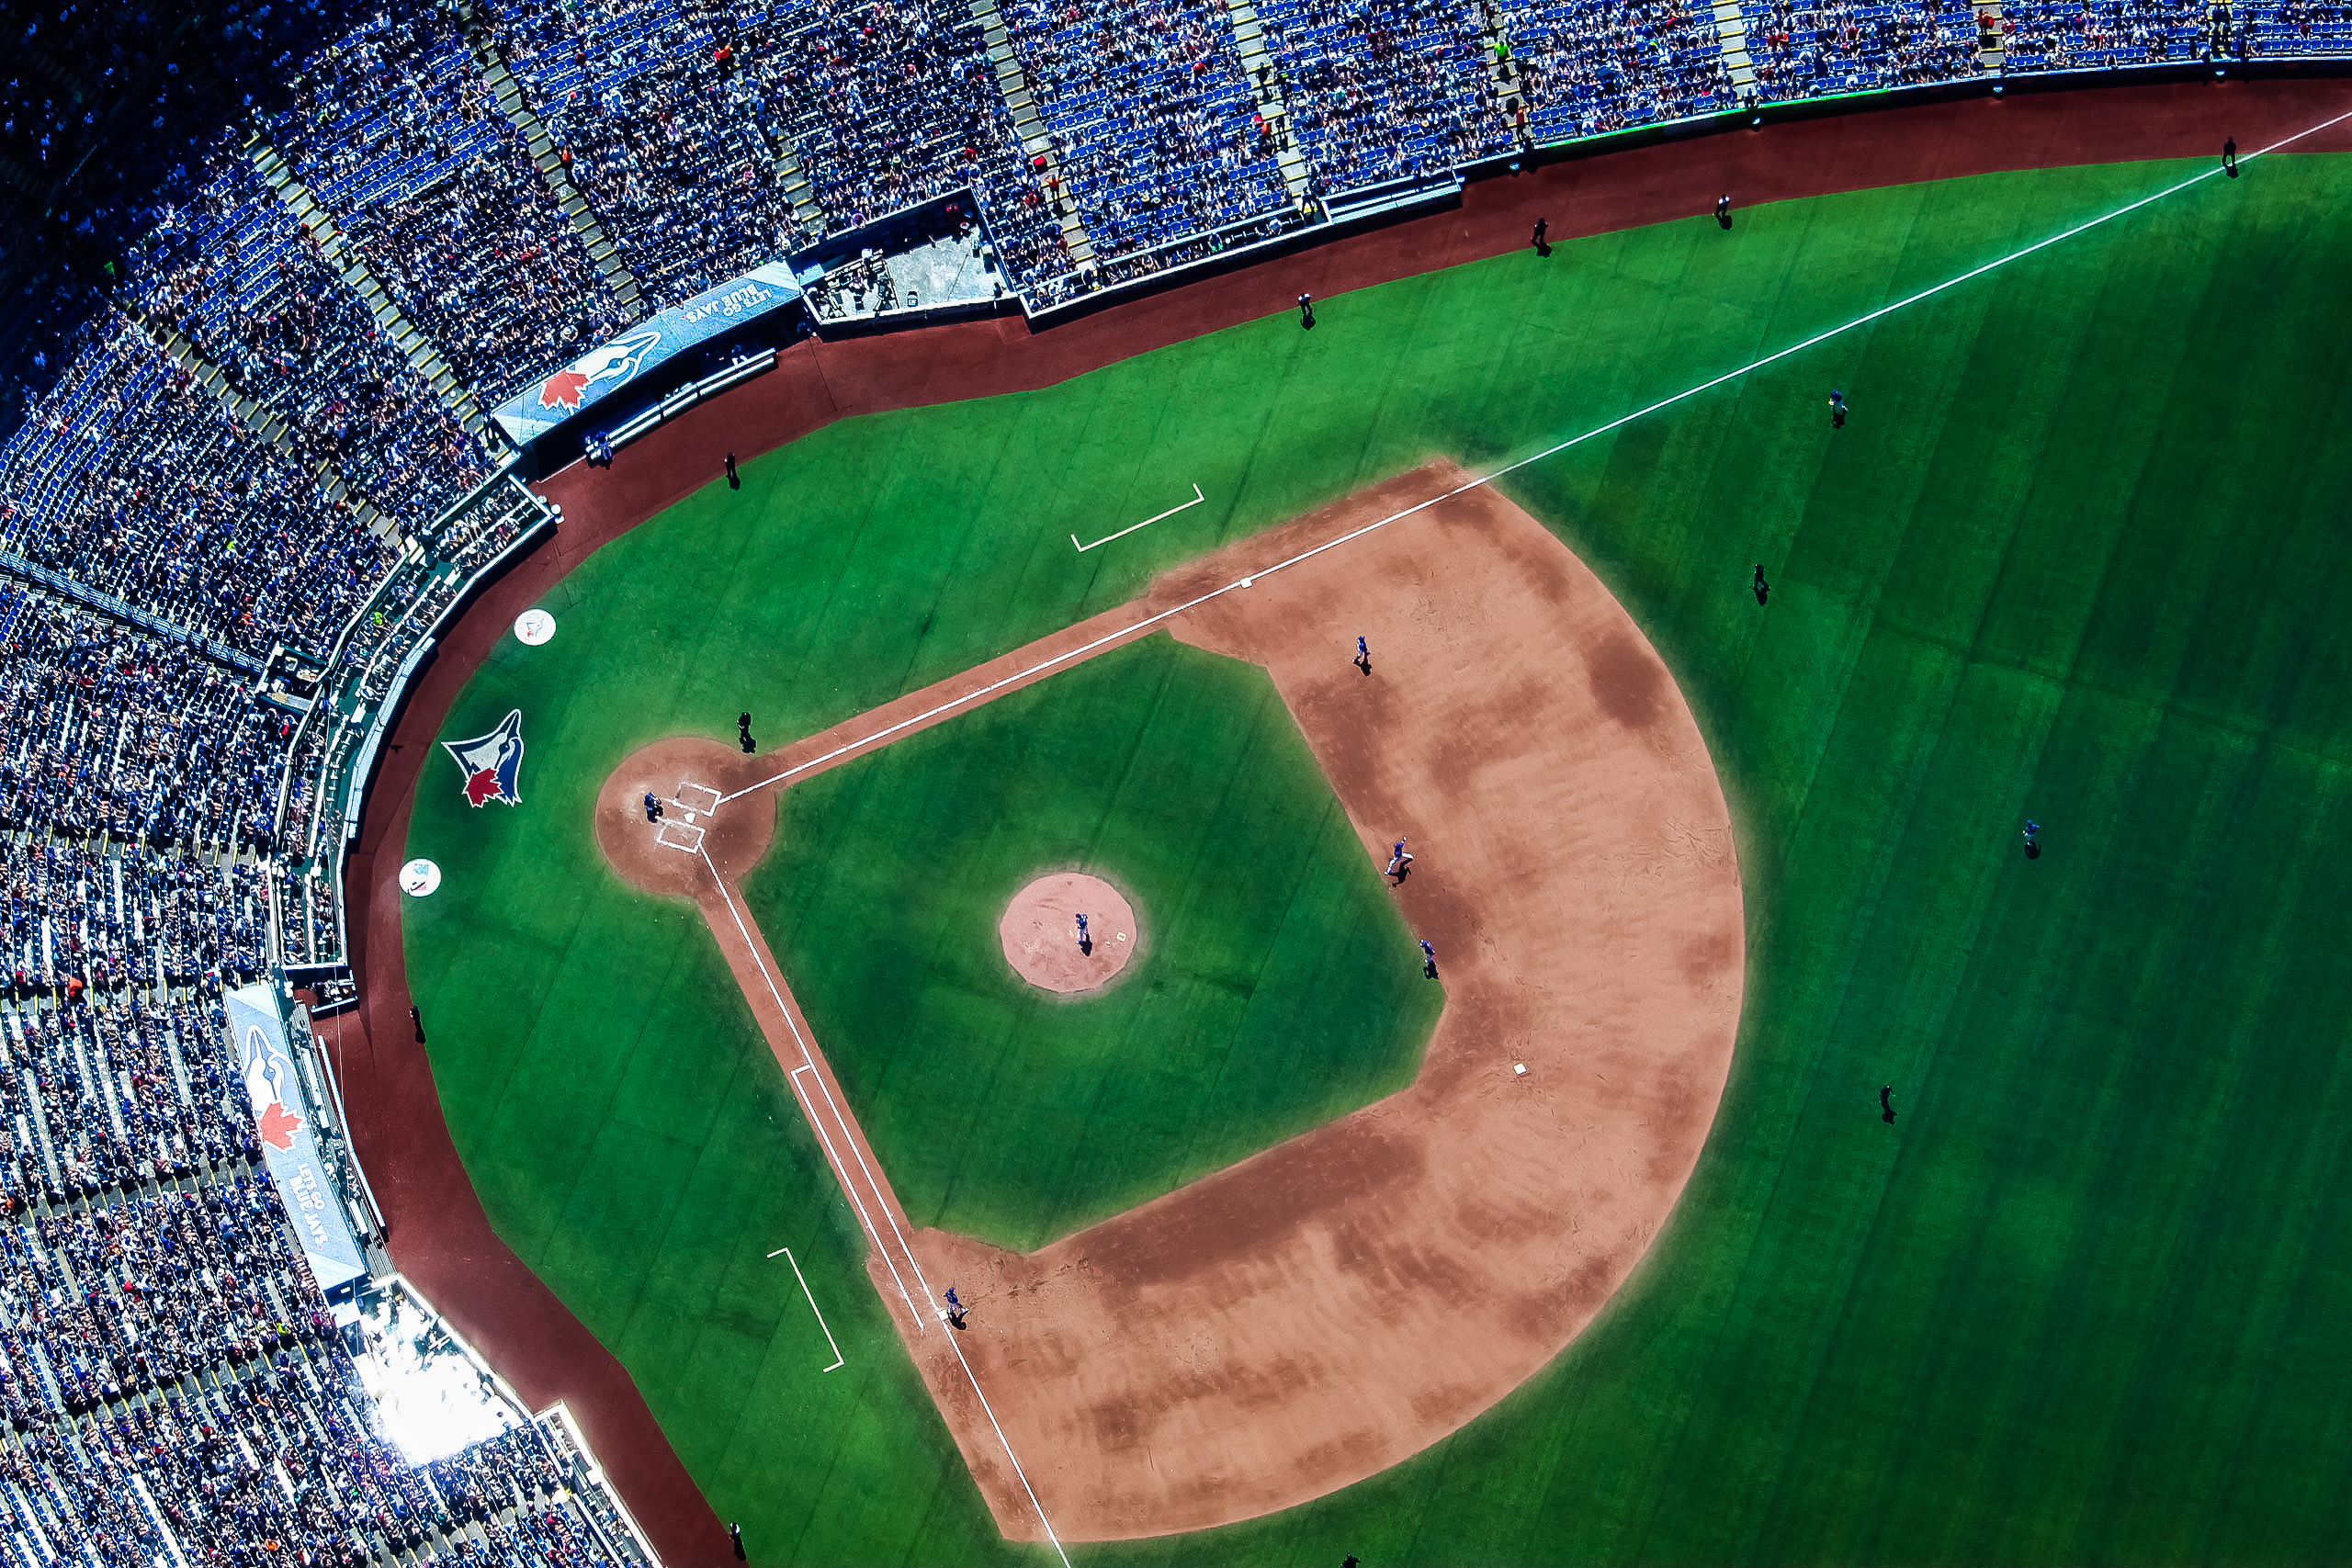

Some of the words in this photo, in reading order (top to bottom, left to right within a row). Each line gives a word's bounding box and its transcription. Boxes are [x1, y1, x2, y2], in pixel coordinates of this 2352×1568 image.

[720, 283, 758, 307] BLUE
[685, 299, 719, 323] JAYS
[722, 303, 742, 317] GO
[288, 1175, 315, 1212] BLUE
[304, 1212, 328, 1245] JAYS
[310, 1190, 325, 1211] GO
